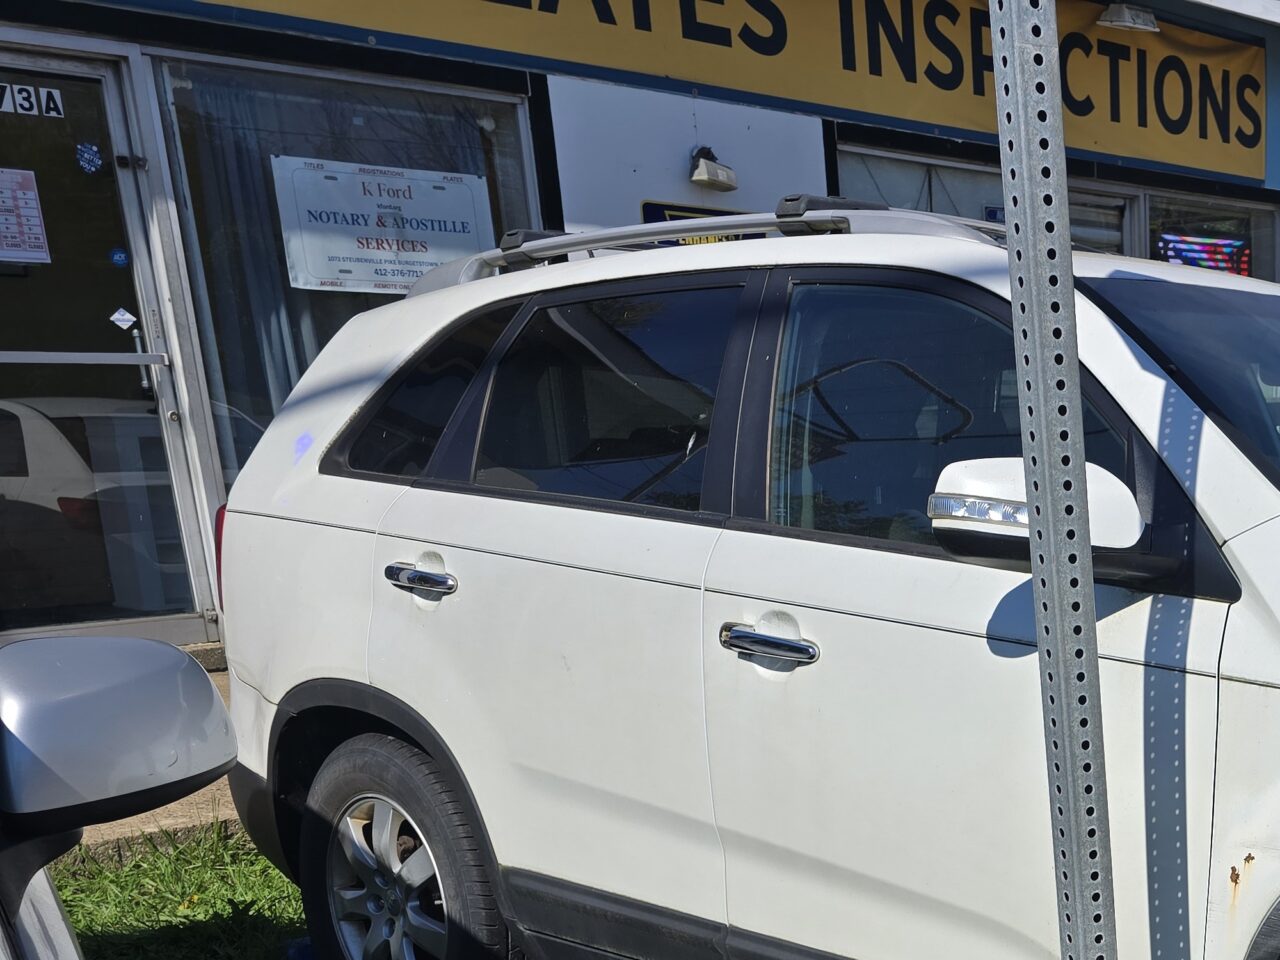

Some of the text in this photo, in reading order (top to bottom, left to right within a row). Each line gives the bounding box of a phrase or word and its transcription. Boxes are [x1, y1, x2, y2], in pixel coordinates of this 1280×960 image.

[838, 0, 1262, 149] INSPCTIONS
[79, 160, 91, 170] YOU
[303, 162, 325, 170] TITLES
[358, 167, 405, 178] REGISTRATIONS
[442, 175, 464, 183] PLATES
[361, 181, 414, 200] K Ford
[306, 209, 471, 234] NOTARY & APOSTILLE
[356, 237, 428, 253] SERVICES
[341, 256, 383, 265] STEUBENVILLE
[320, 280, 343, 288] MOBILE
[374, 282, 398, 290] REMOTE
